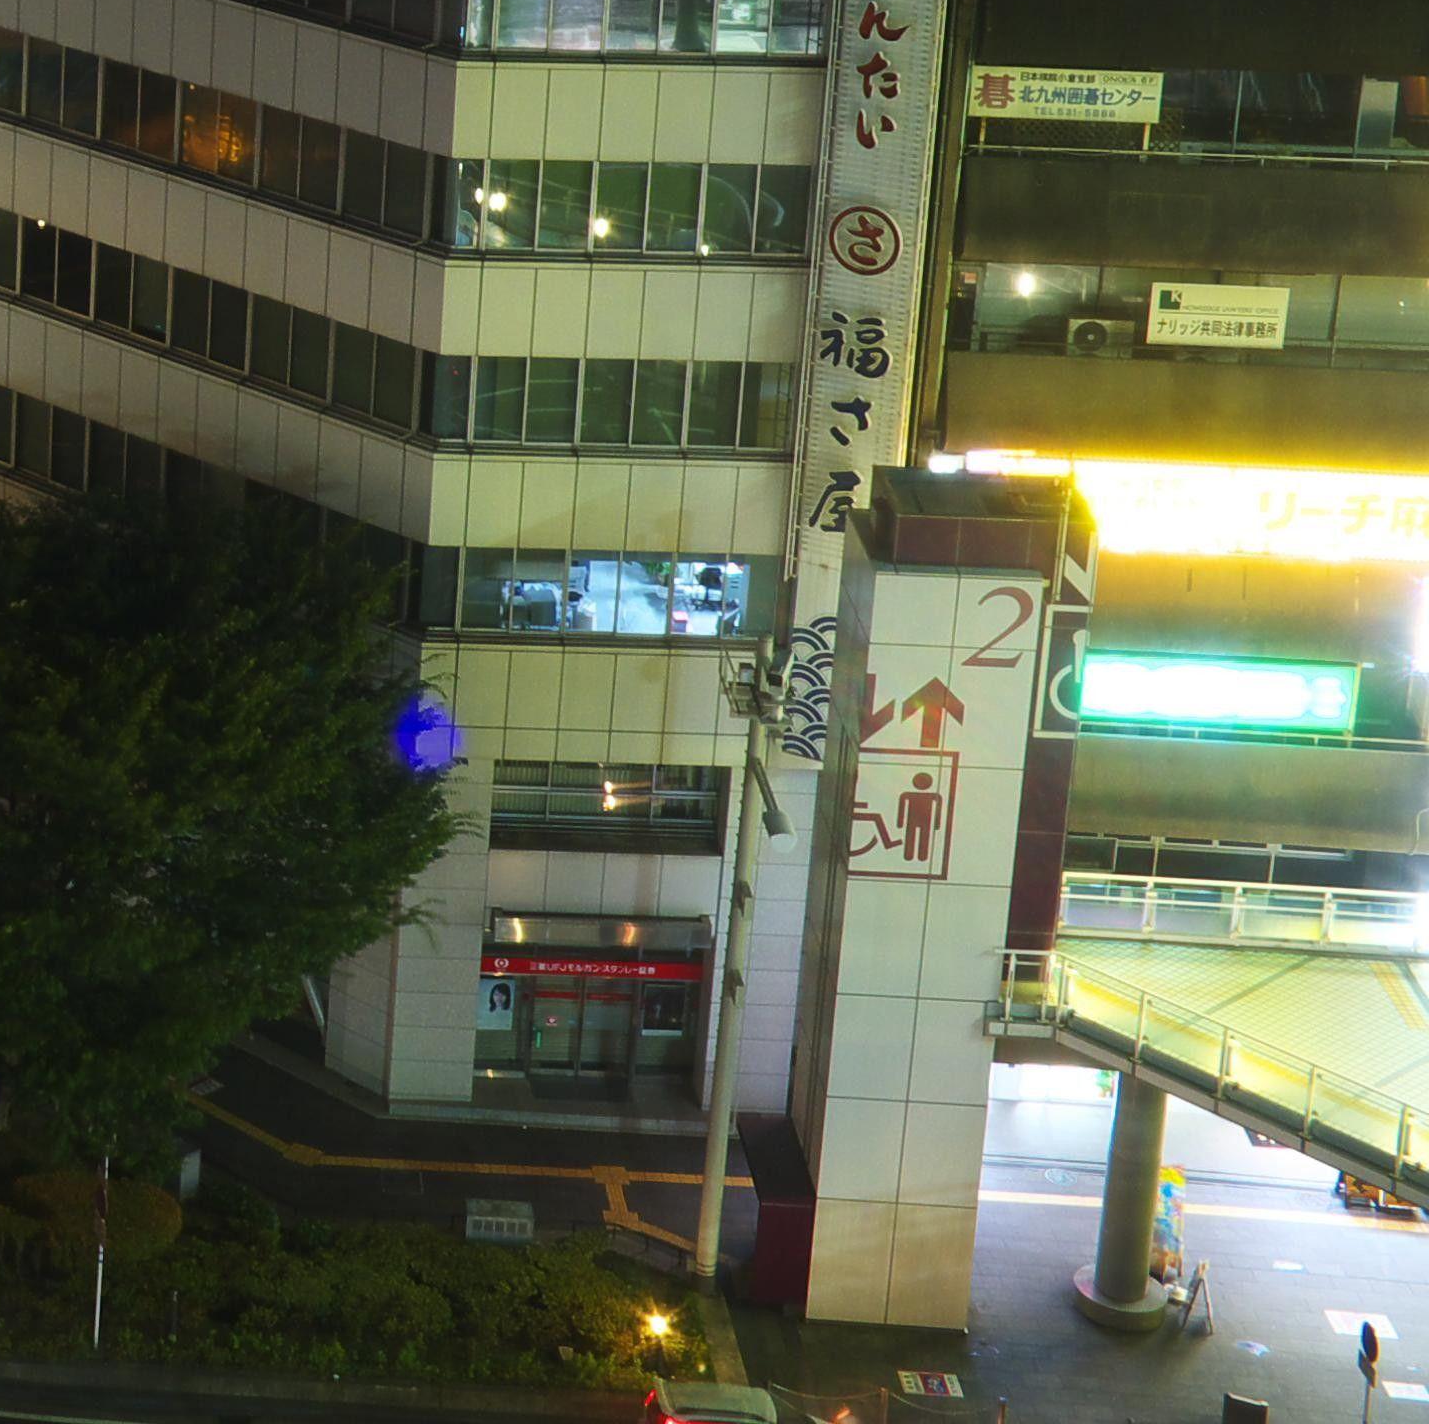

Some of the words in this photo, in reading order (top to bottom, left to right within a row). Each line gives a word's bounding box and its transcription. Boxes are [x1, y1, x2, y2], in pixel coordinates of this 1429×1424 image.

[1018, 85, 1156, 107] 北九州囲碁センター
[1156, 318, 1279, 339] ナリッジ共同法律事務所
[960, 586, 1035, 668] 2
